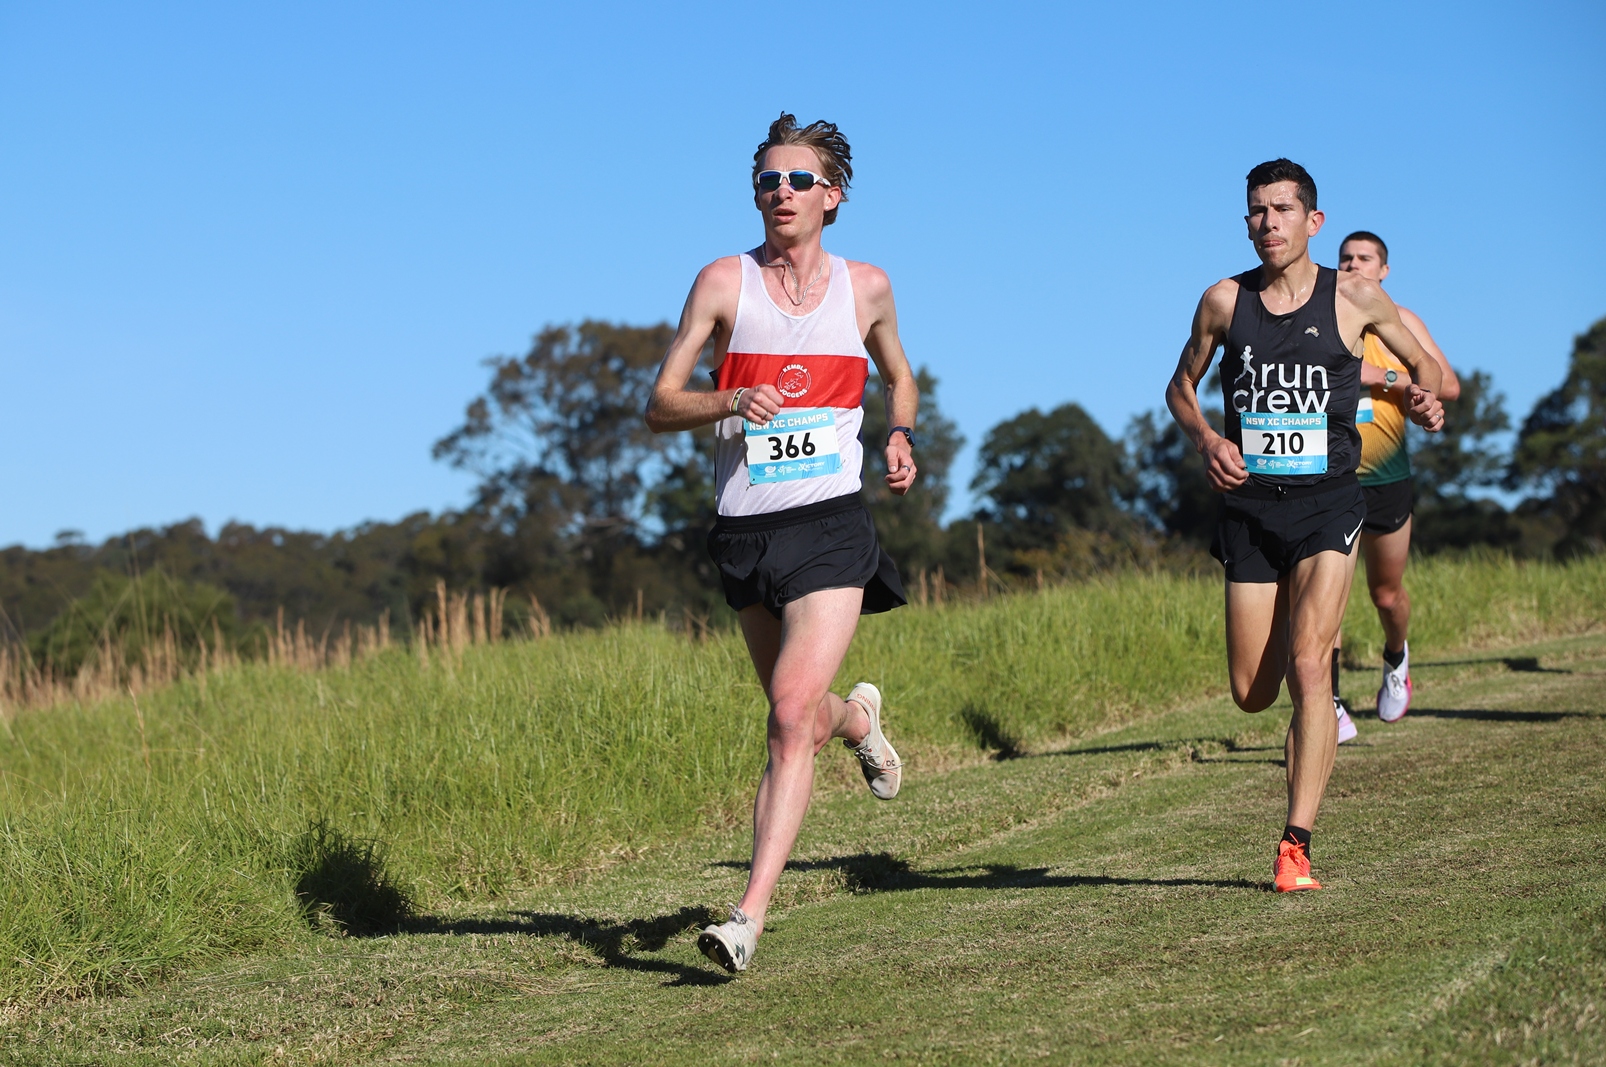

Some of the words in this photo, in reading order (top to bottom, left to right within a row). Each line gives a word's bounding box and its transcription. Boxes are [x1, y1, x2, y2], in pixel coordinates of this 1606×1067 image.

[782, 364, 808, 374] KEMBLA
[1261, 363, 1329, 390] run
[779, 388, 808, 398] JOGGERS
[1232, 389, 1331, 413] crew
[749, 421, 770, 431] NSW
[772, 419, 786, 429] XC
[787, 413, 829, 427] CHAMPS
[1245, 417, 1265, 425] NSW
[1267, 418, 1280, 426] XC
[1281, 417, 1322, 426] CHAMPS
[767, 432, 816, 460] 366
[1262, 432, 1304, 455] 210
